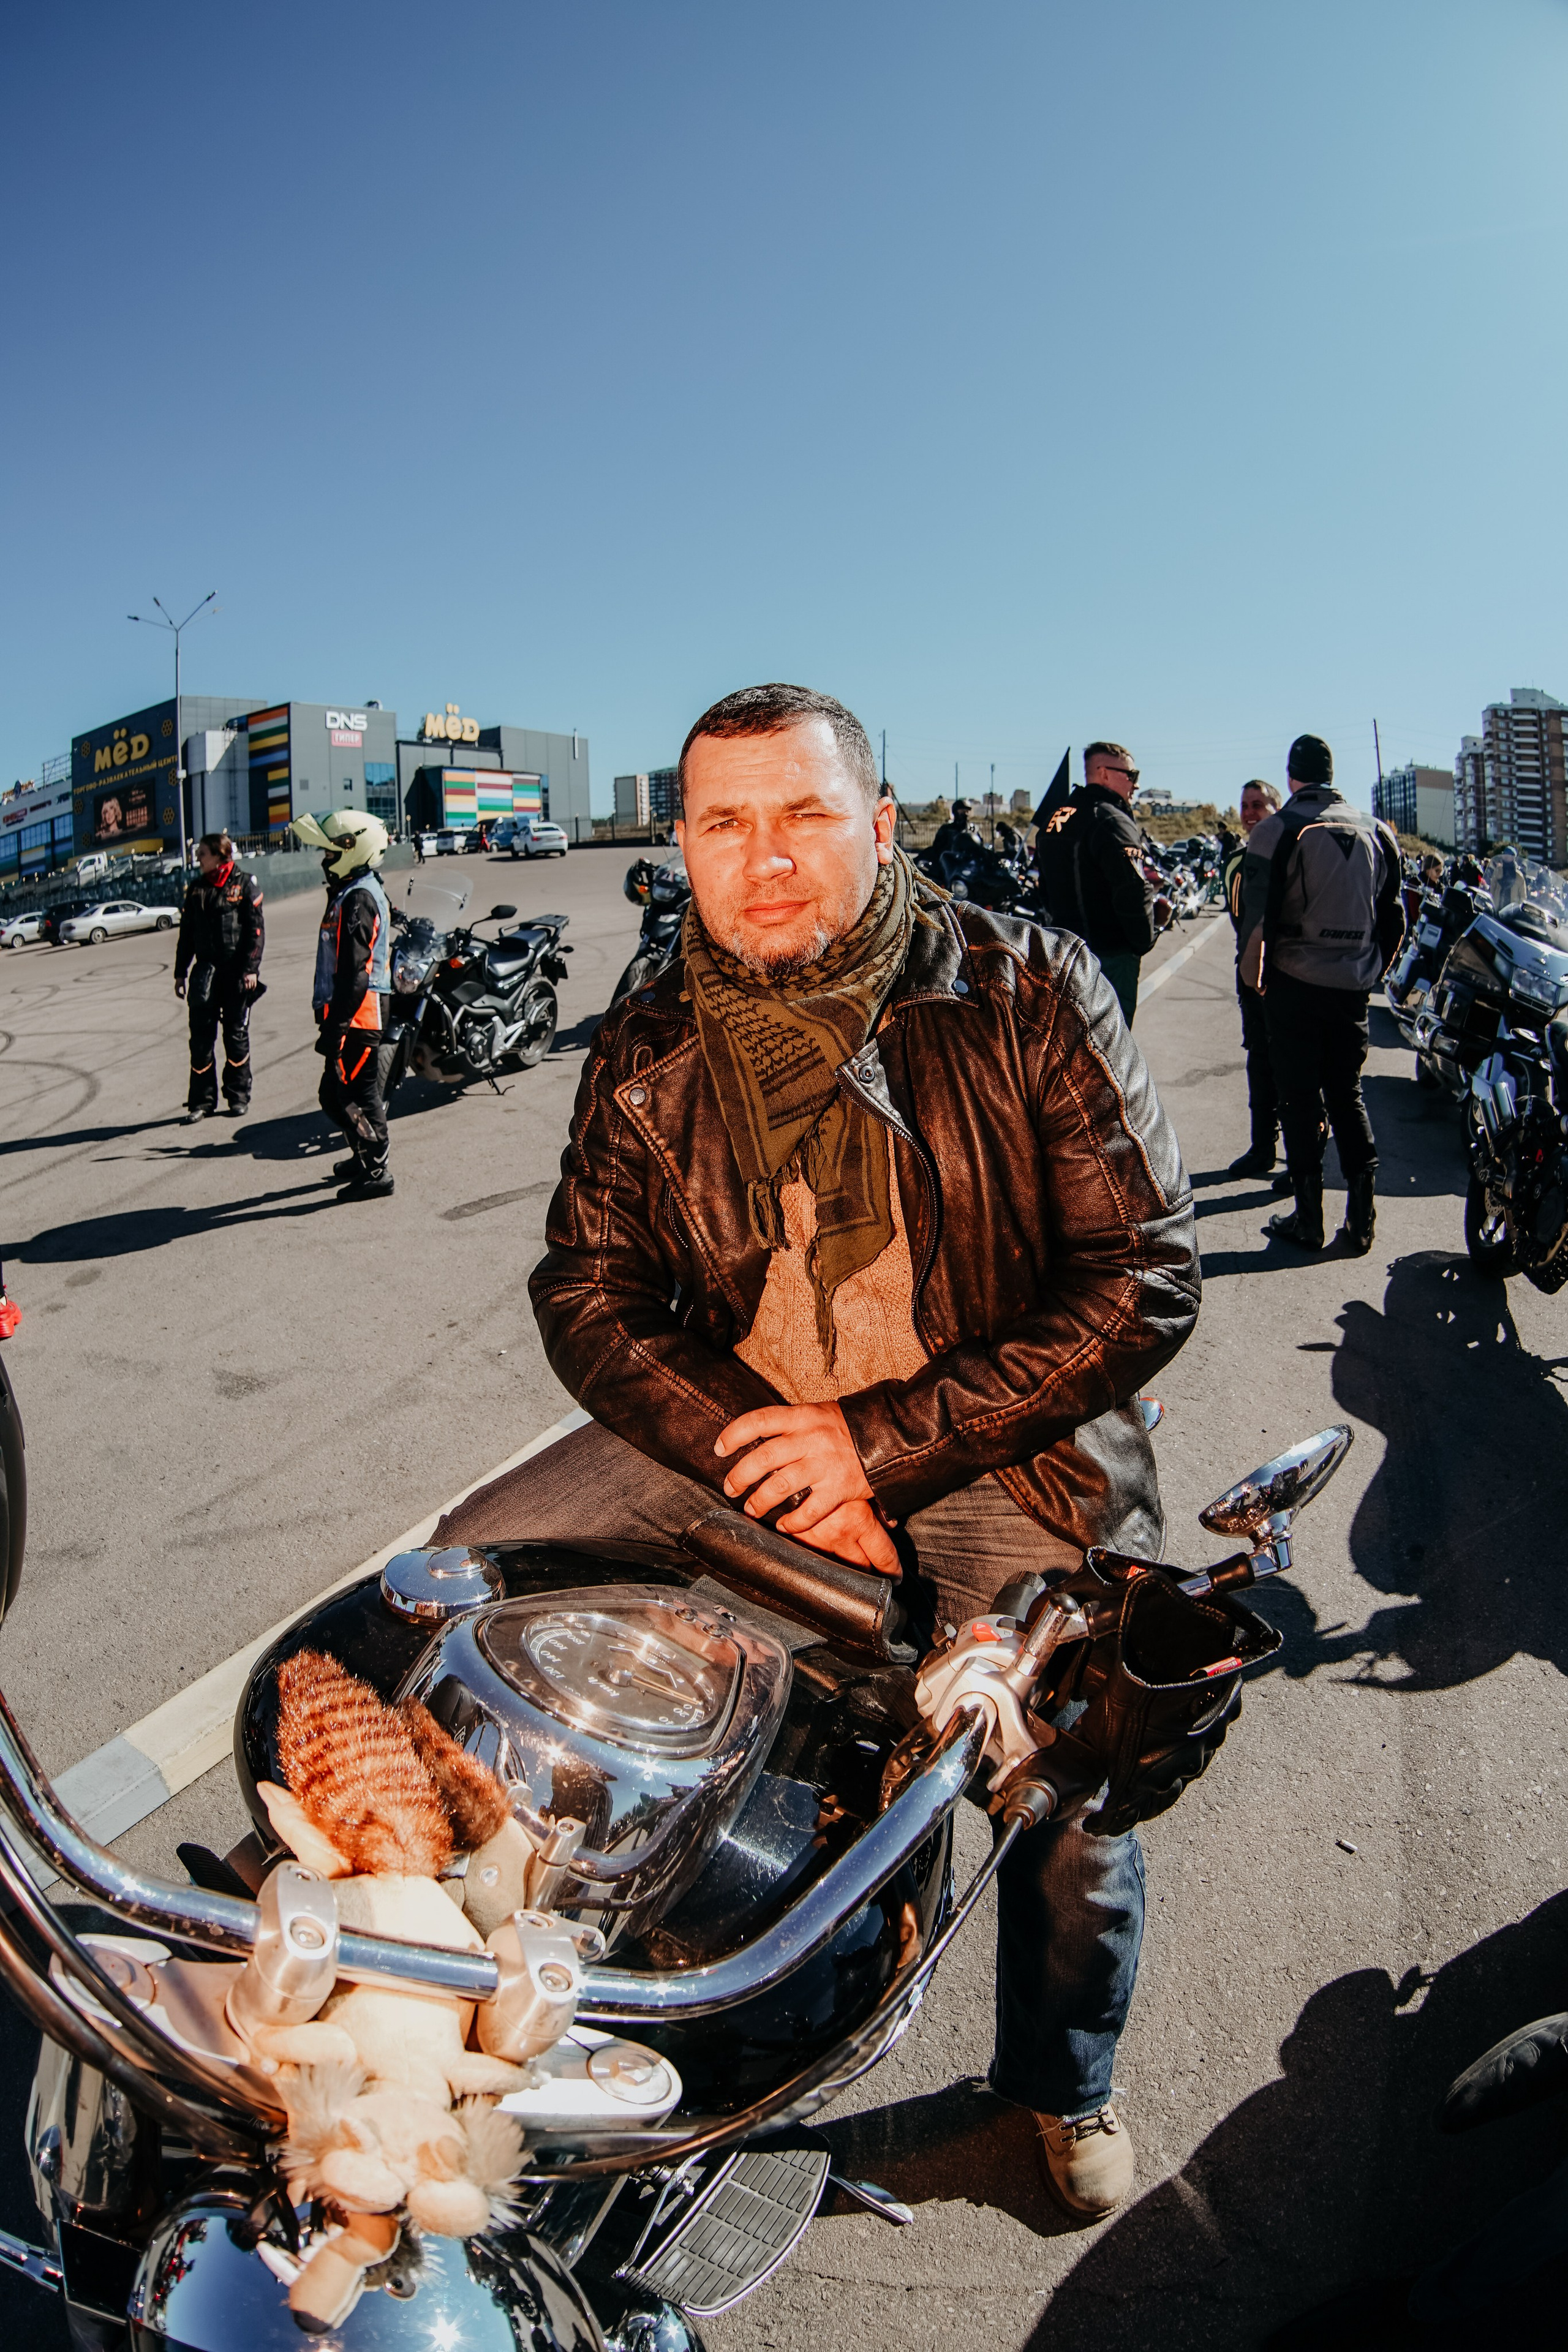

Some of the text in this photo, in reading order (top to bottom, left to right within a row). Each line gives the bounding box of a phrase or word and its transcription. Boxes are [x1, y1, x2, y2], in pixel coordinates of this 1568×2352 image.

[326, 710, 368, 731] DNS
[548, 1639, 568, 1650] 160
[567, 1634, 586, 1646] 180
[540, 1650, 562, 1663] 140
[544, 1666, 566, 1679] 120
[673, 1707, 690, 1717] 20
